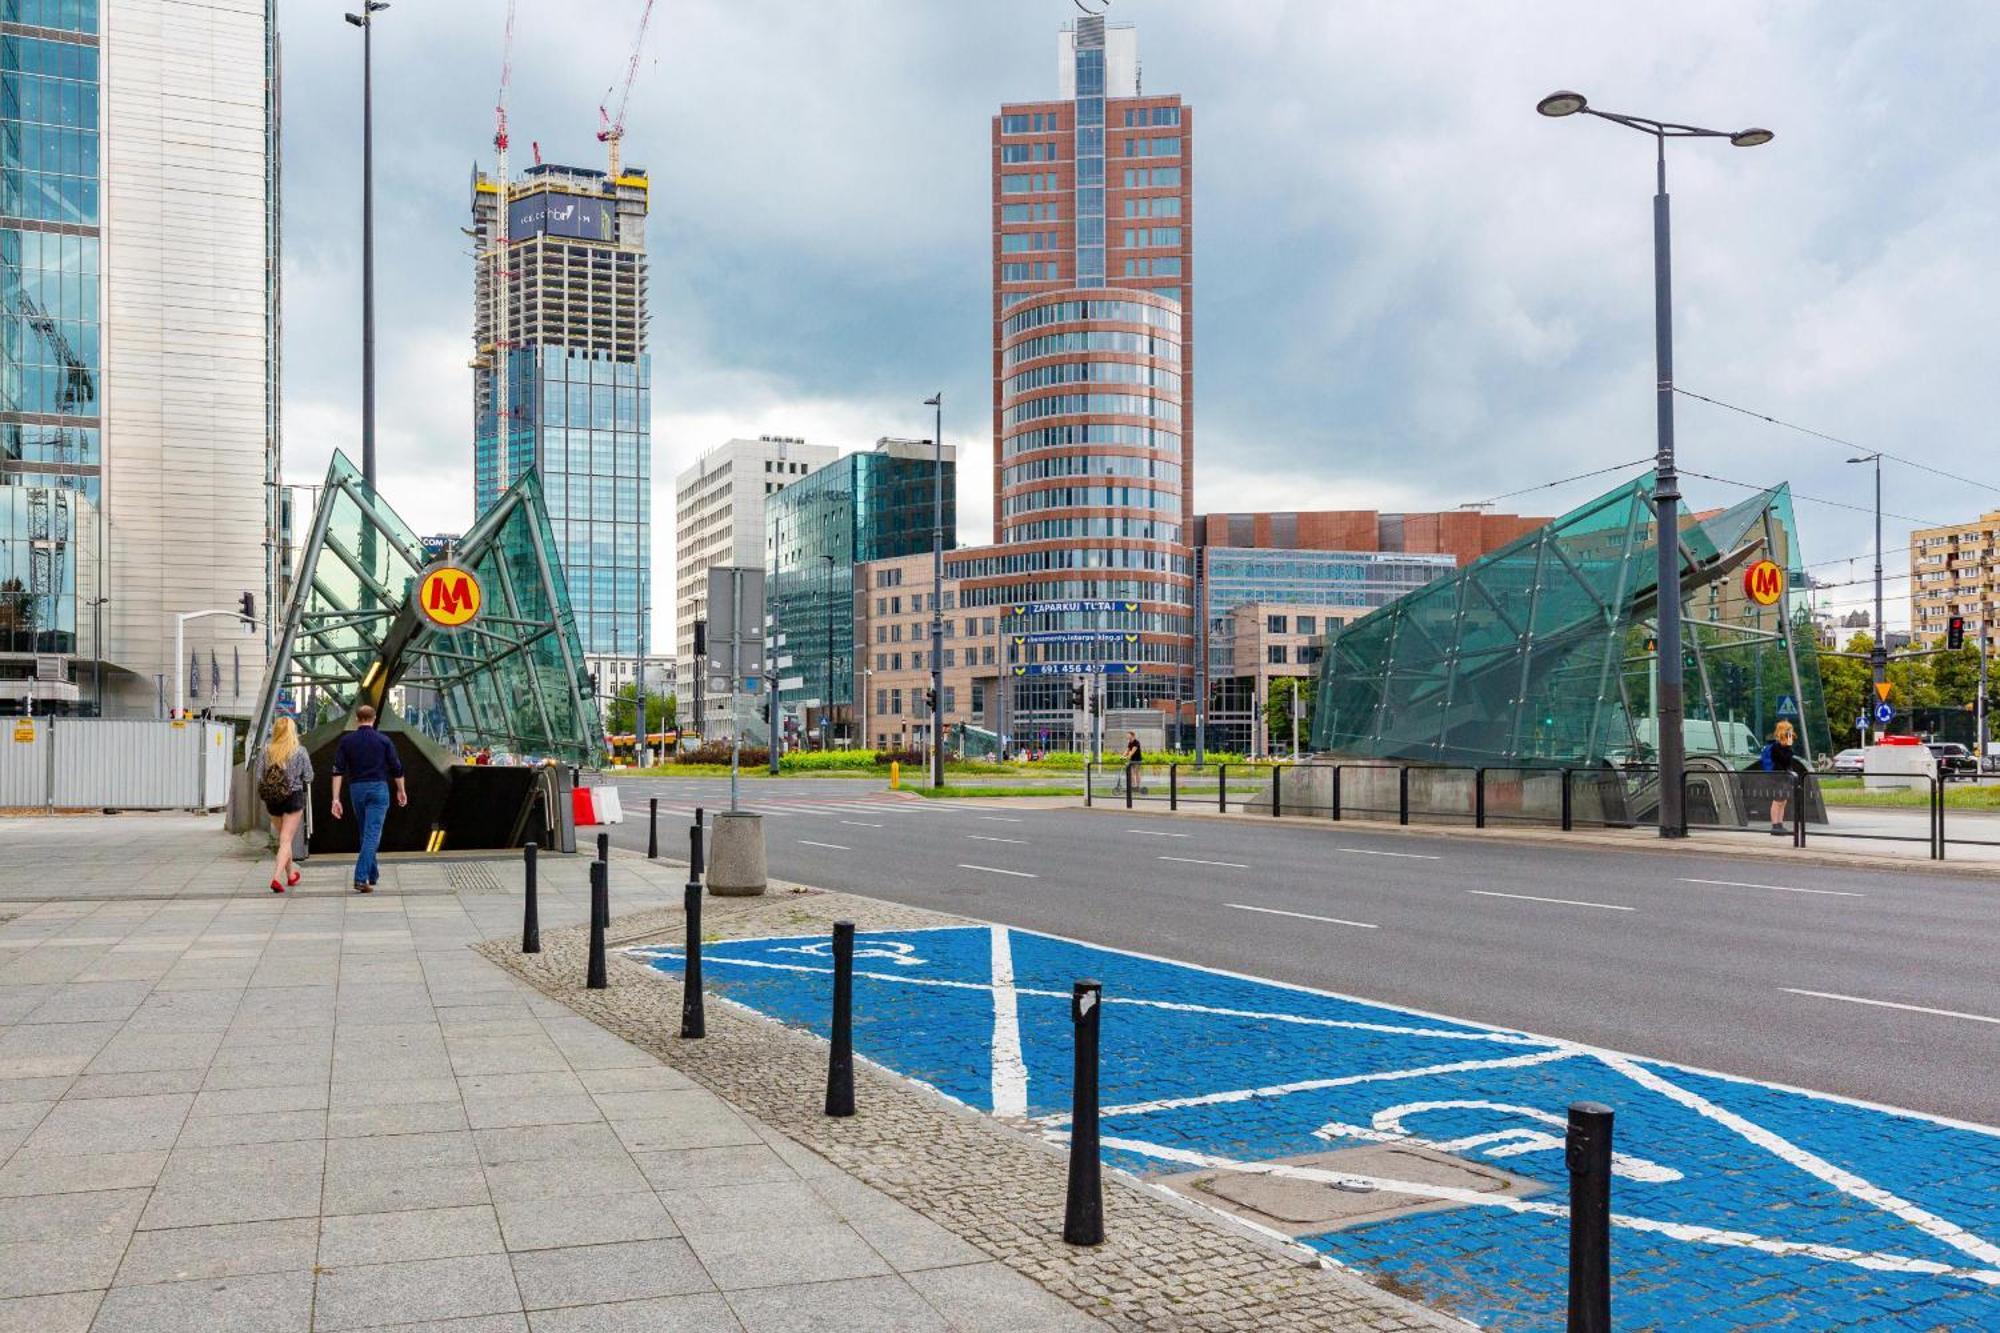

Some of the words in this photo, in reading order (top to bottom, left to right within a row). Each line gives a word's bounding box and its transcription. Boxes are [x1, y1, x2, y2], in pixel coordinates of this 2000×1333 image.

[1756, 568, 1779, 597] M
[429, 577, 473, 615] M
[1033, 602, 1080, 613] ZAPARKUJ
[1027, 633, 1124, 643] bonamenty.interpaking.pl
[1041, 664, 1058, 673] 691
[1062, 664, 1082, 673] 456
